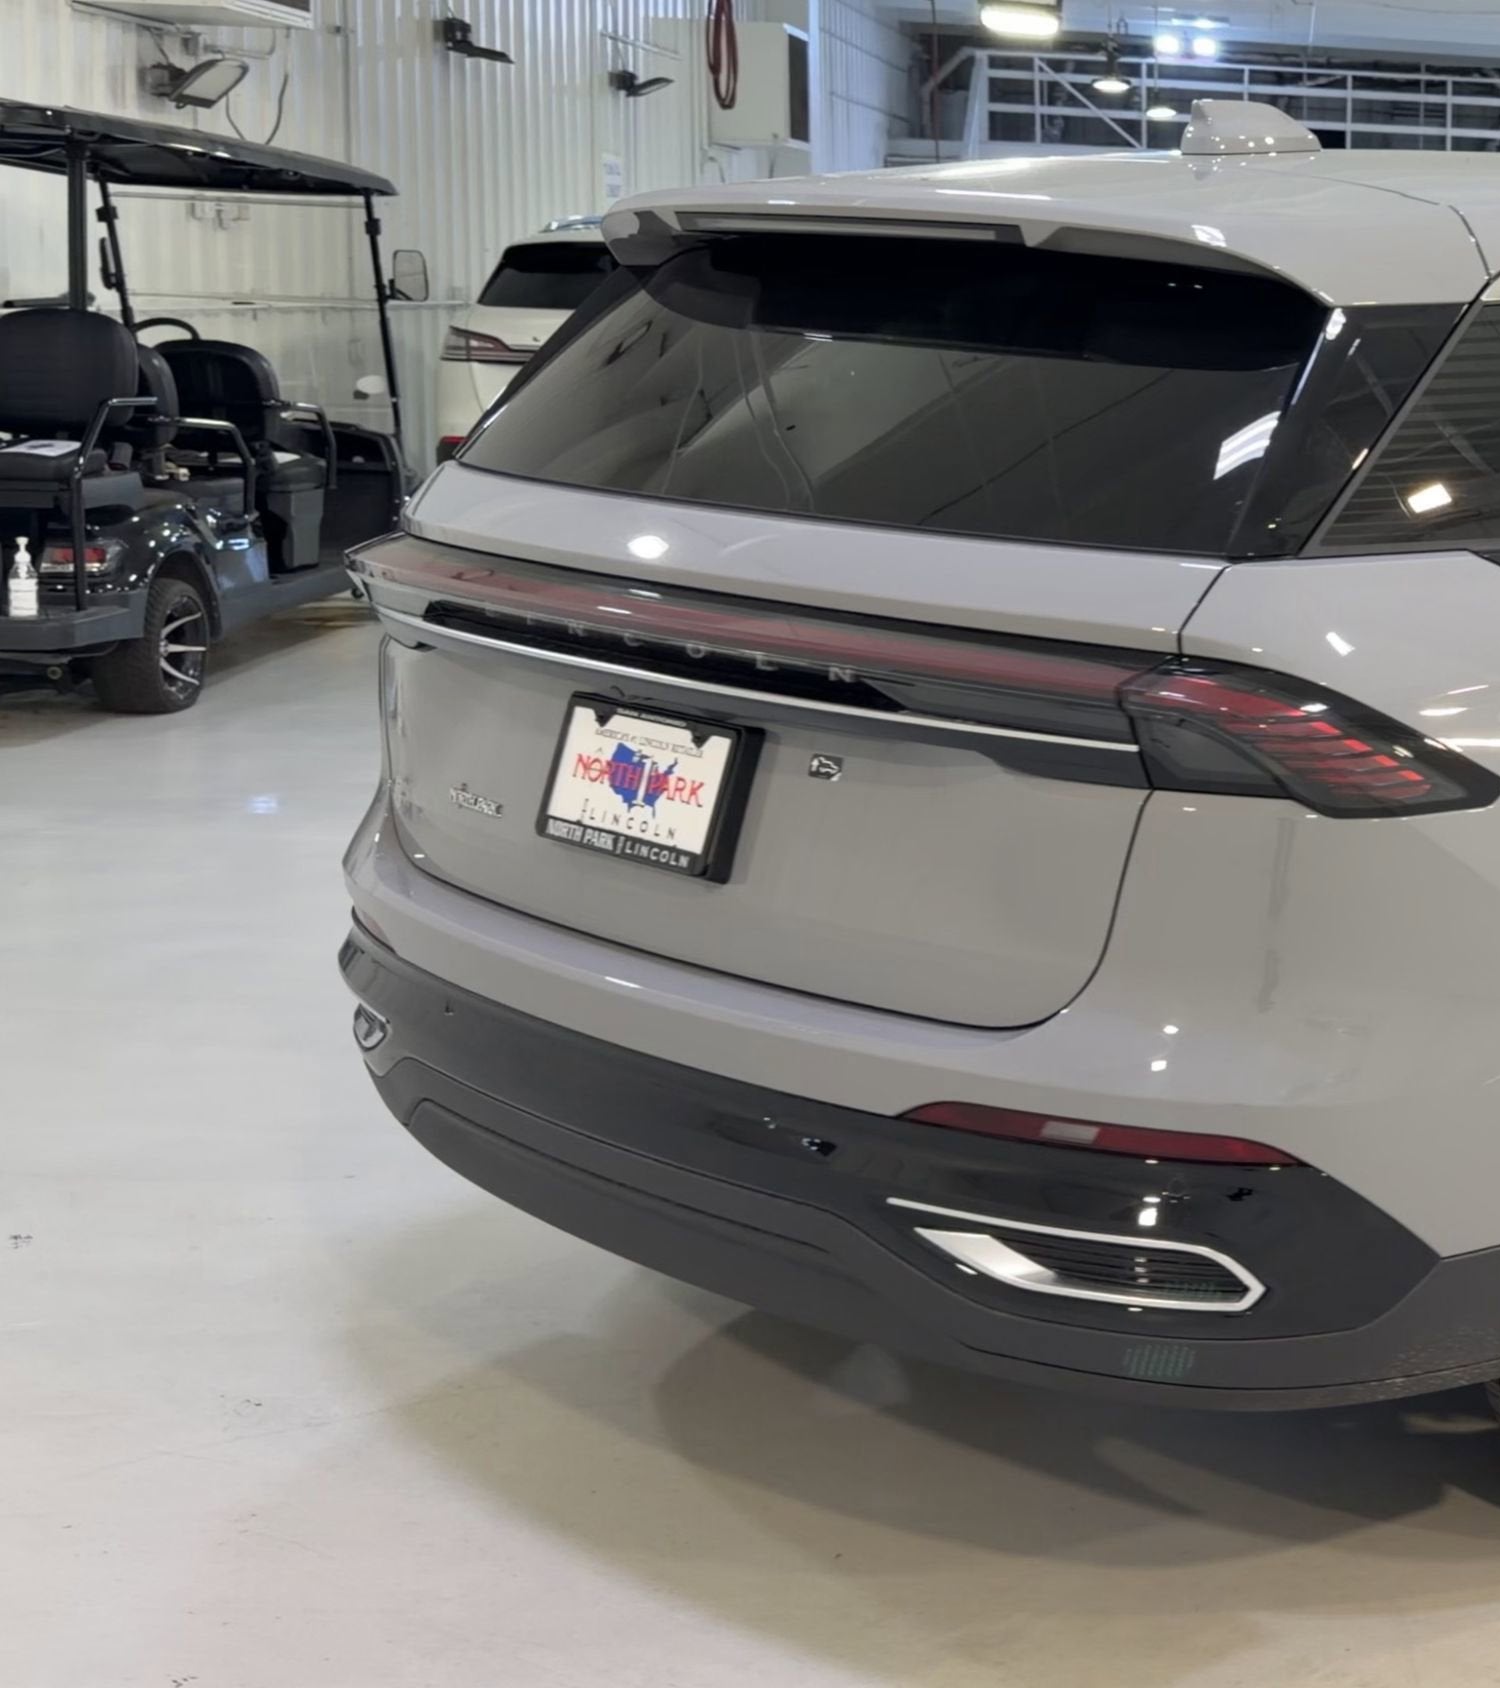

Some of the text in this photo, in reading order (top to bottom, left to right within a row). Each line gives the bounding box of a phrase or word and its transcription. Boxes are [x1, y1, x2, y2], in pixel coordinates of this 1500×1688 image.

[572, 753, 705, 807] NORTH PARK
[546, 818, 690, 868] NORTH PARK LINCOLN
[589, 807, 677, 840] LINCOLN
